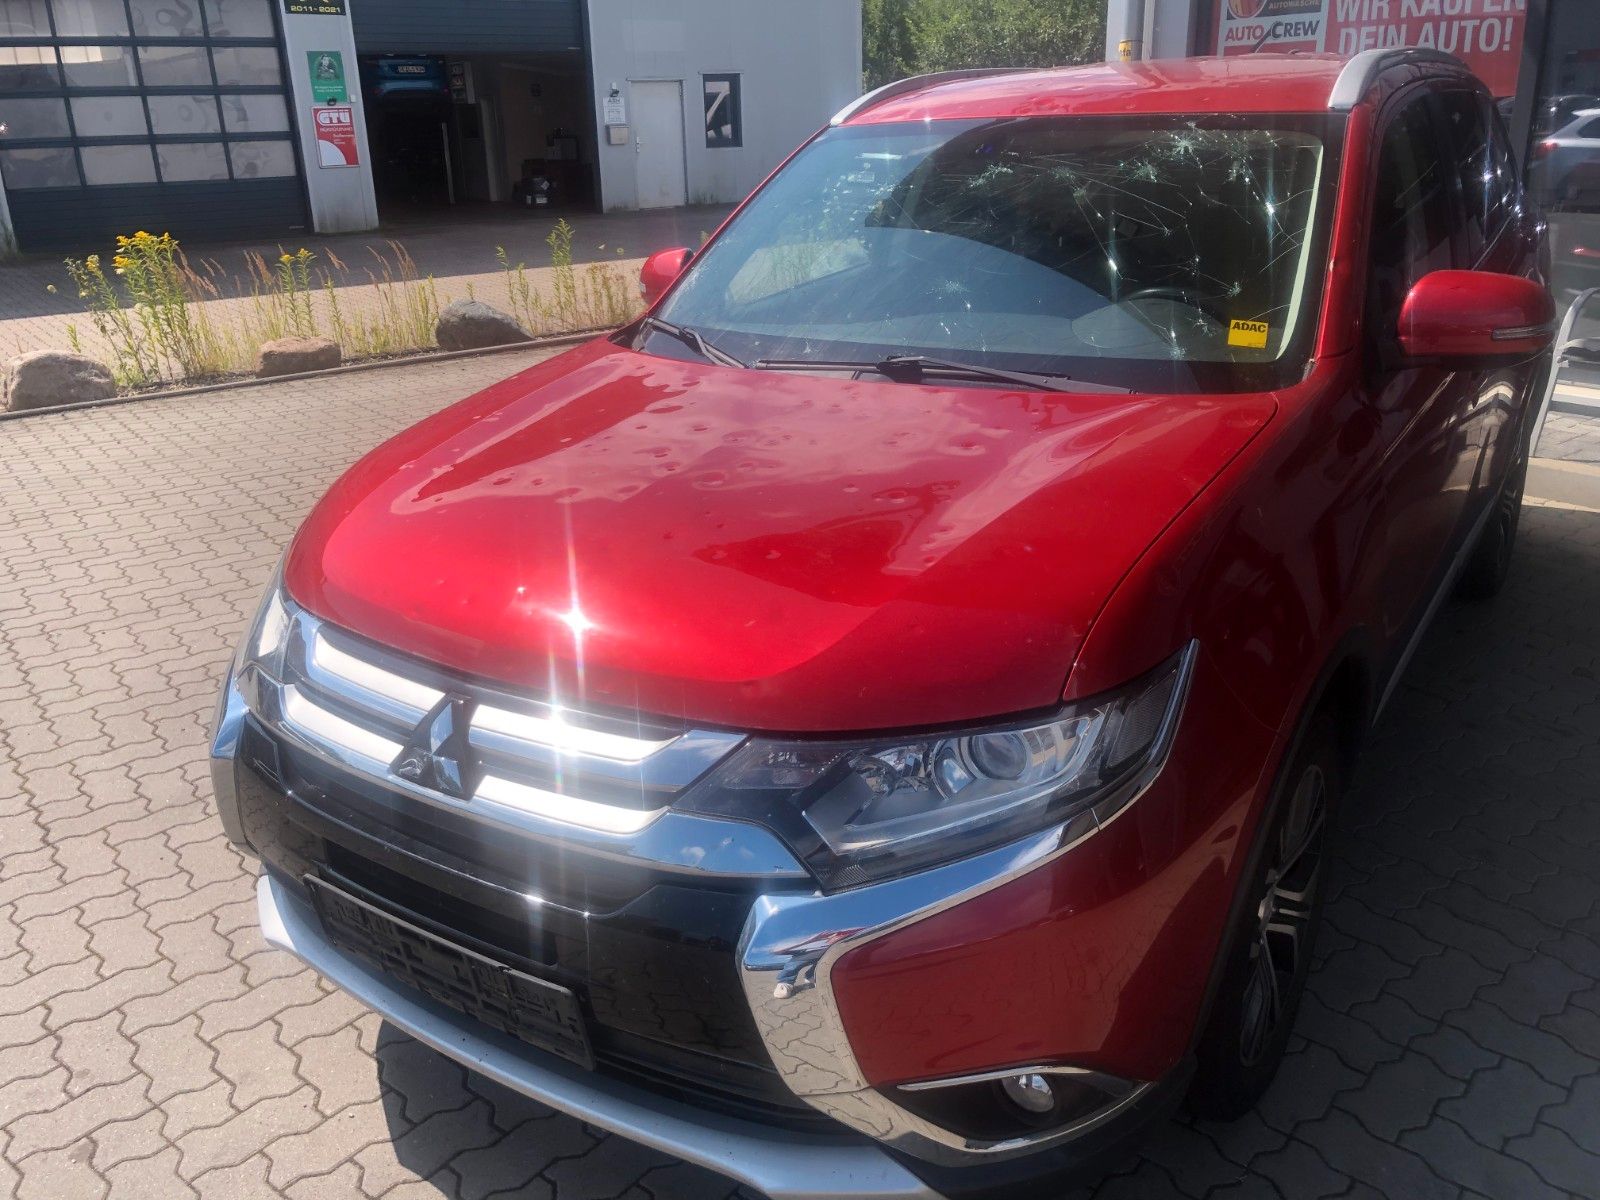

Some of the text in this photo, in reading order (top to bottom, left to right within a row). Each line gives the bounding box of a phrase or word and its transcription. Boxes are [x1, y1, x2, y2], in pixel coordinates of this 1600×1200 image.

[1225, 20, 1320, 41] AUTO CREW
[1338, 18, 1513, 55] DEIN AUTO!
[1232, 321, 1267, 333] ADAC
